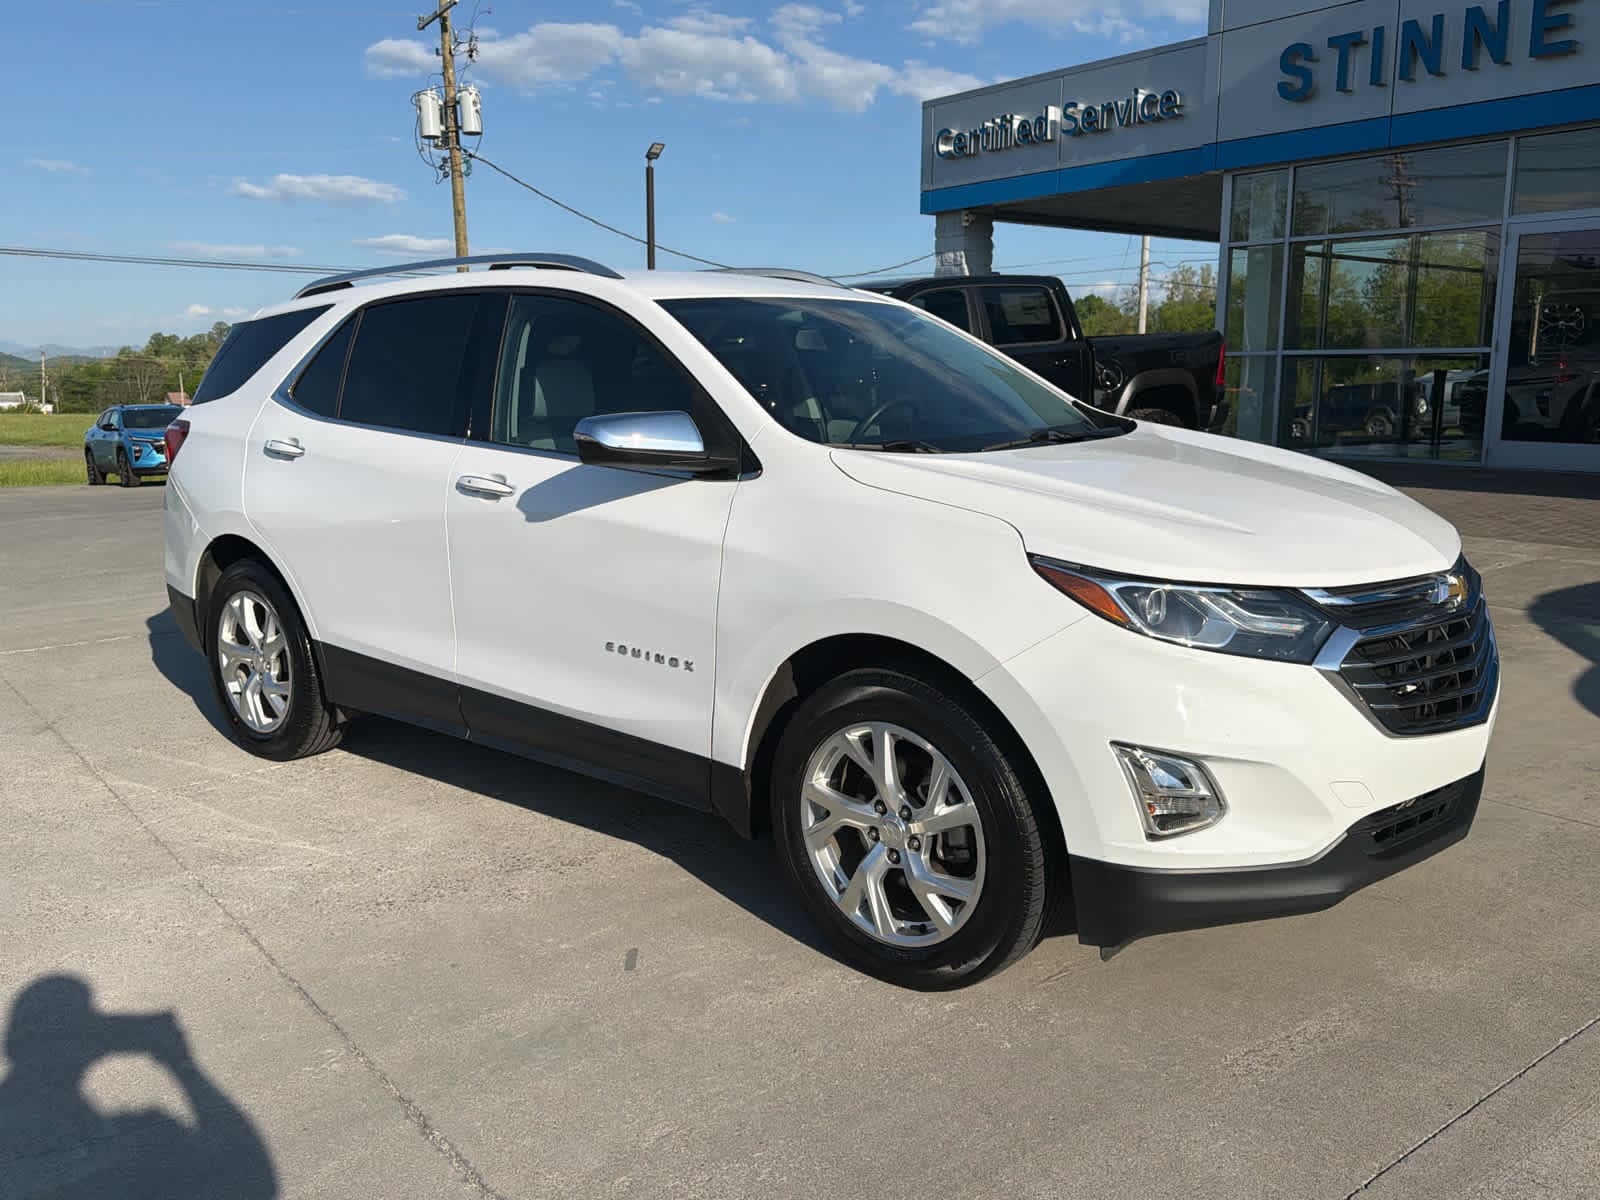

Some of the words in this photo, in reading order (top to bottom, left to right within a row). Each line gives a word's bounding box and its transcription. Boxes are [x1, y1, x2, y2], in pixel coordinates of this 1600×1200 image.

[1277, 0, 1577, 101] STINNE
[935, 105, 1056, 158] Certified
[1061, 87, 1181, 136] Service
[605, 641, 694, 672] EQUINOX
